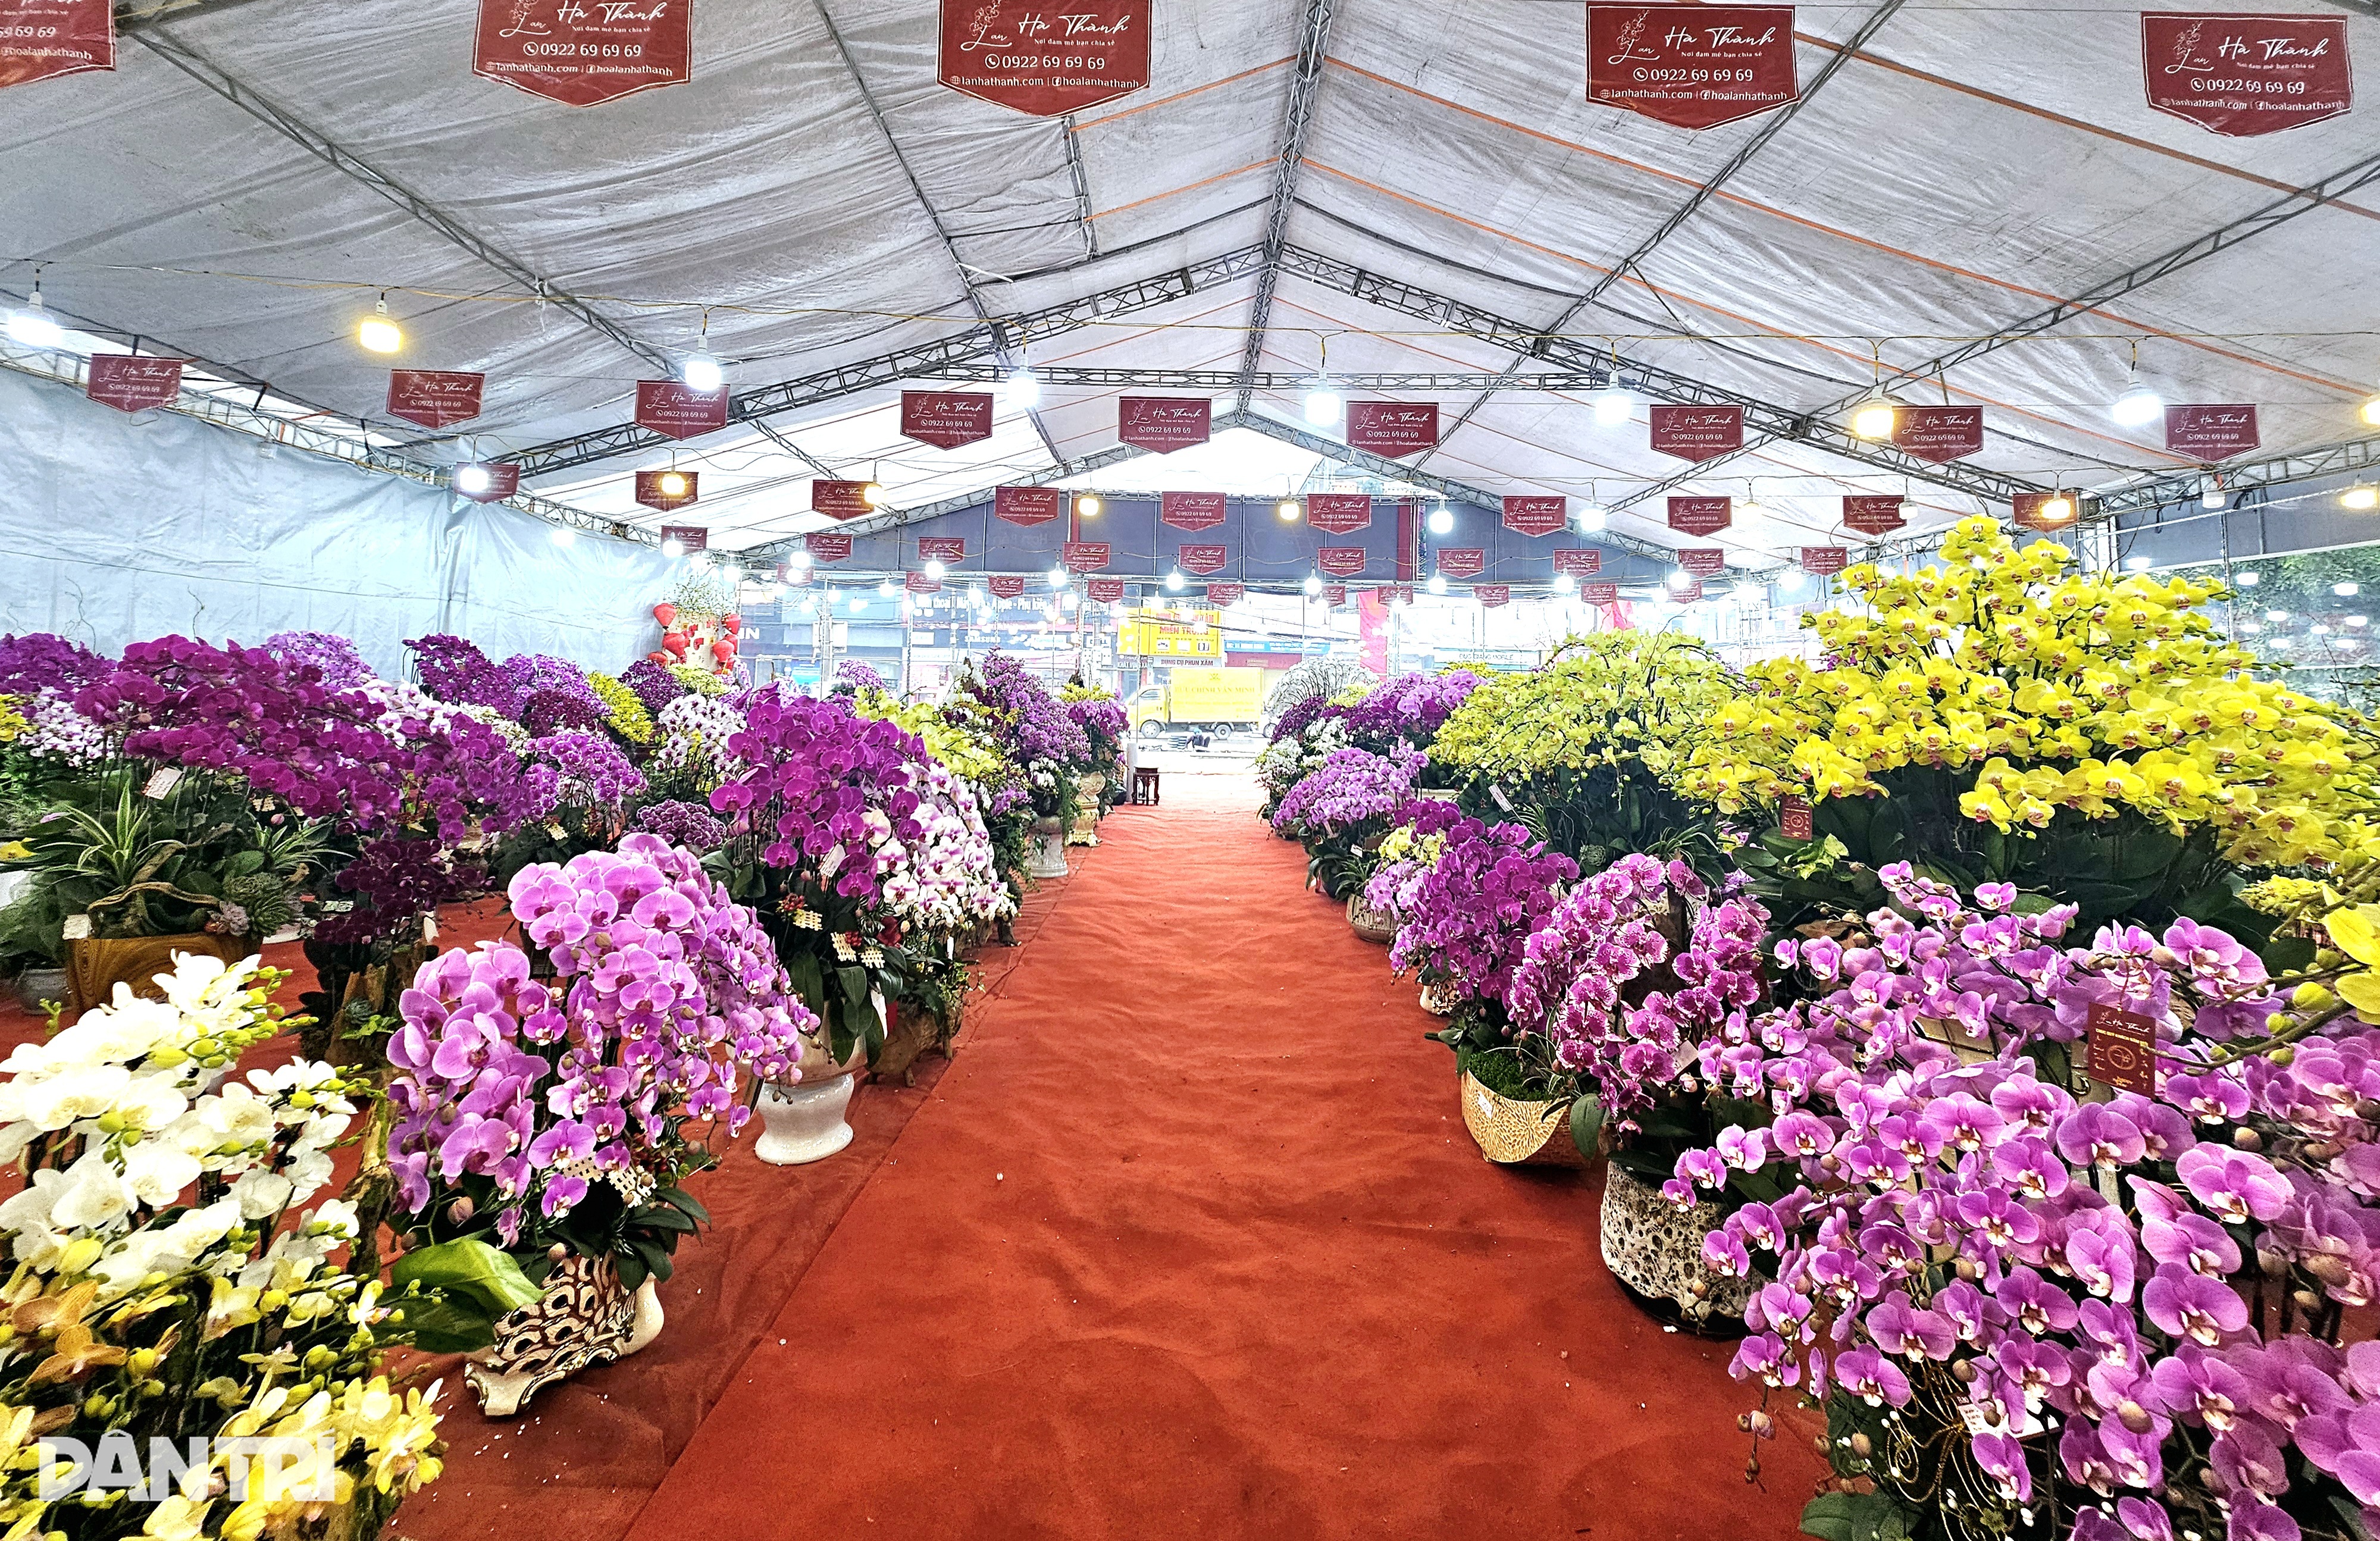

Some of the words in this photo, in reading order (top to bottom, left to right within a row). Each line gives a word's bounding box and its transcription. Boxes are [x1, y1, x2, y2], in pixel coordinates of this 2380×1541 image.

[15, 26, 33, 37] 69
[37, 27, 56, 38] 69
[541, 43, 575, 56] 0922
[580, 45, 597, 57] 69
[602, 45, 619, 57] 69
[624, 45, 641, 57] 69
[1002, 56, 1038, 68] 0922
[1042, 55, 1060, 68] 69
[1064, 55, 1082, 68] 69
[1088, 57, 1105, 70] 69
[497, 62, 578, 73] lanhathanh.com
[596, 65, 672, 77] hoalanhathanh
[1651, 69, 1687, 81] 0922
[1691, 69, 1709, 82] 69
[1713, 69, 1731, 82] 69
[1736, 69, 1753, 82] 69
[962, 76, 1043, 87] lanhathanh.com
[1062, 76, 1139, 89] hoalanhathanh
[2207, 79, 2243, 91] 0922
[2246, 80, 2262, 93] 69
[2266, 81, 2284, 93] 69
[2287, 82, 2305, 95] 69
[1611, 89, 1693, 99] lanhathanh.com
[1711, 90, 1787, 101] hoalanhathanh
[2171, 99, 2247, 110] lanhathanh.com
[2264, 100, 2345, 111] hoalanhathanh
[991, 598, 1012, 612] Apple
